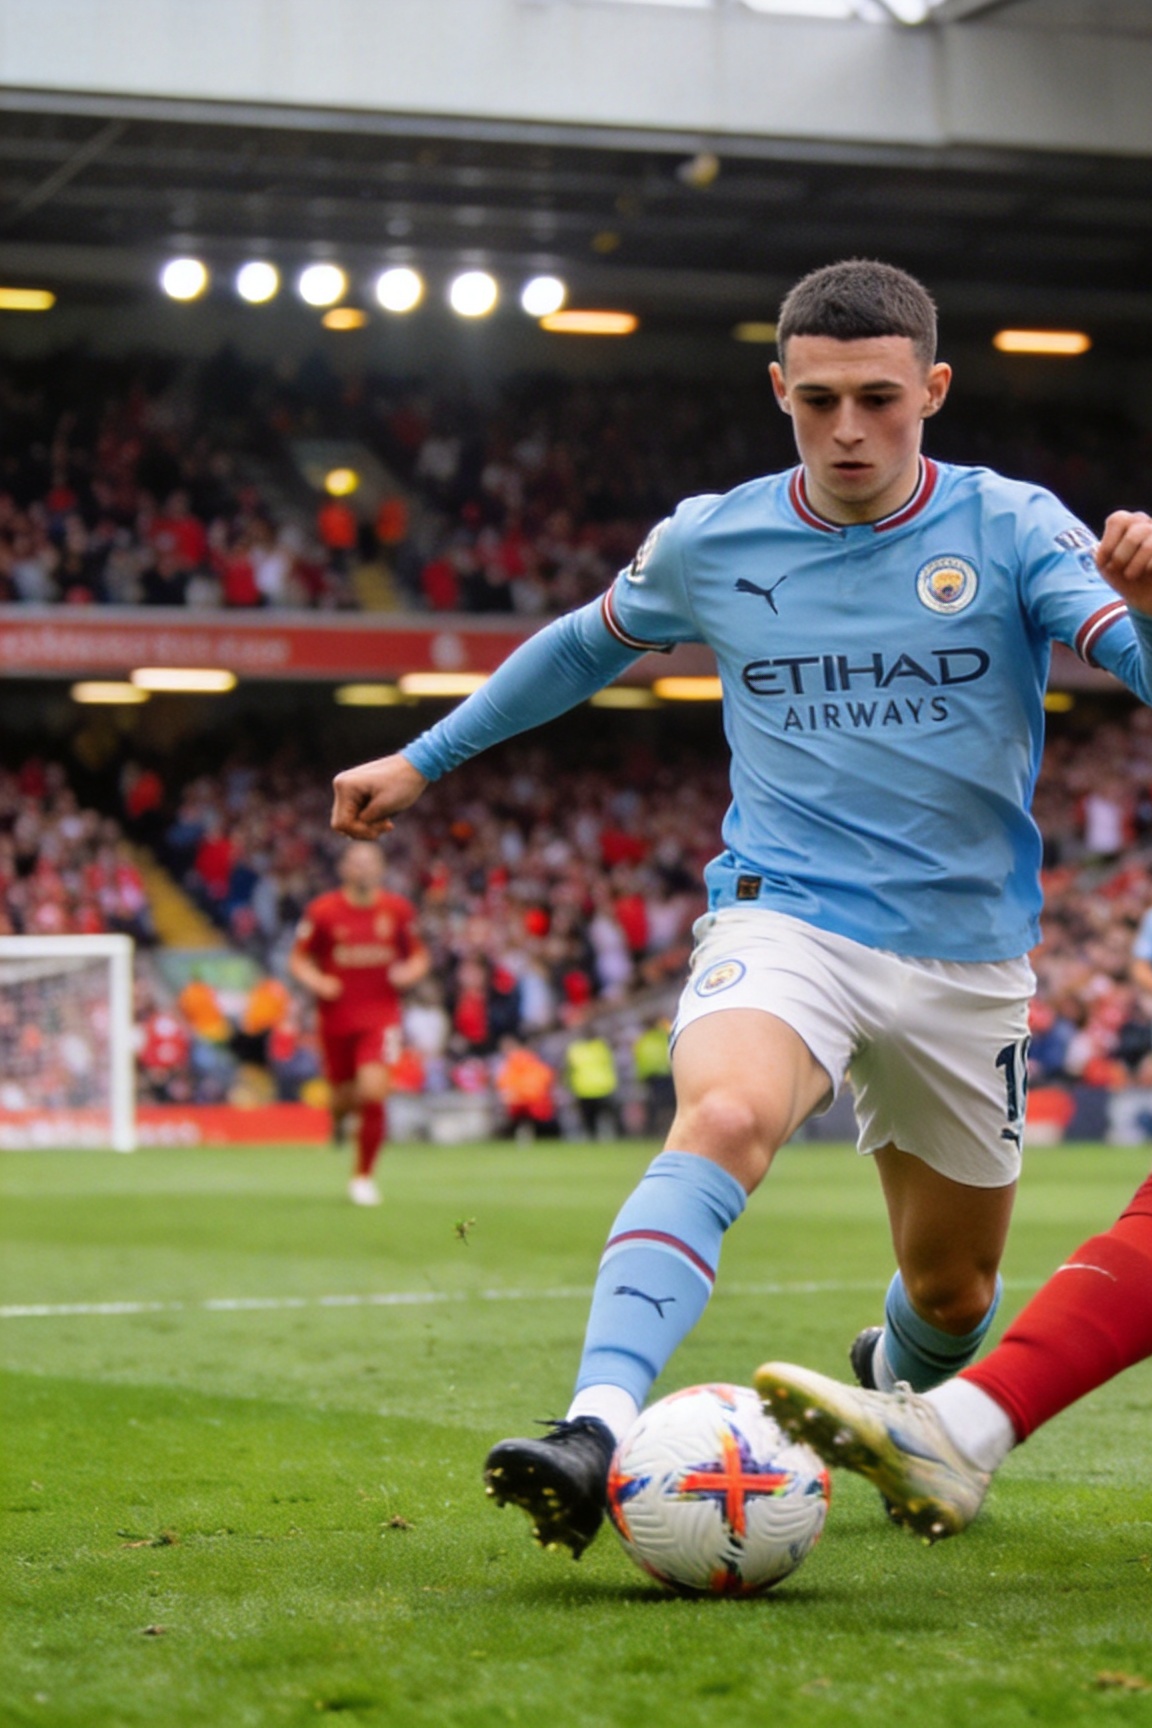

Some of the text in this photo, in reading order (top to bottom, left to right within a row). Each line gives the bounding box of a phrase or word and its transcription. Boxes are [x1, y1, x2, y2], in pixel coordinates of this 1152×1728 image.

[742, 647, 991, 697] ETIHAD
[783, 696, 949, 732] AIRWAYS
[995, 1035, 1030, 1122] 1
